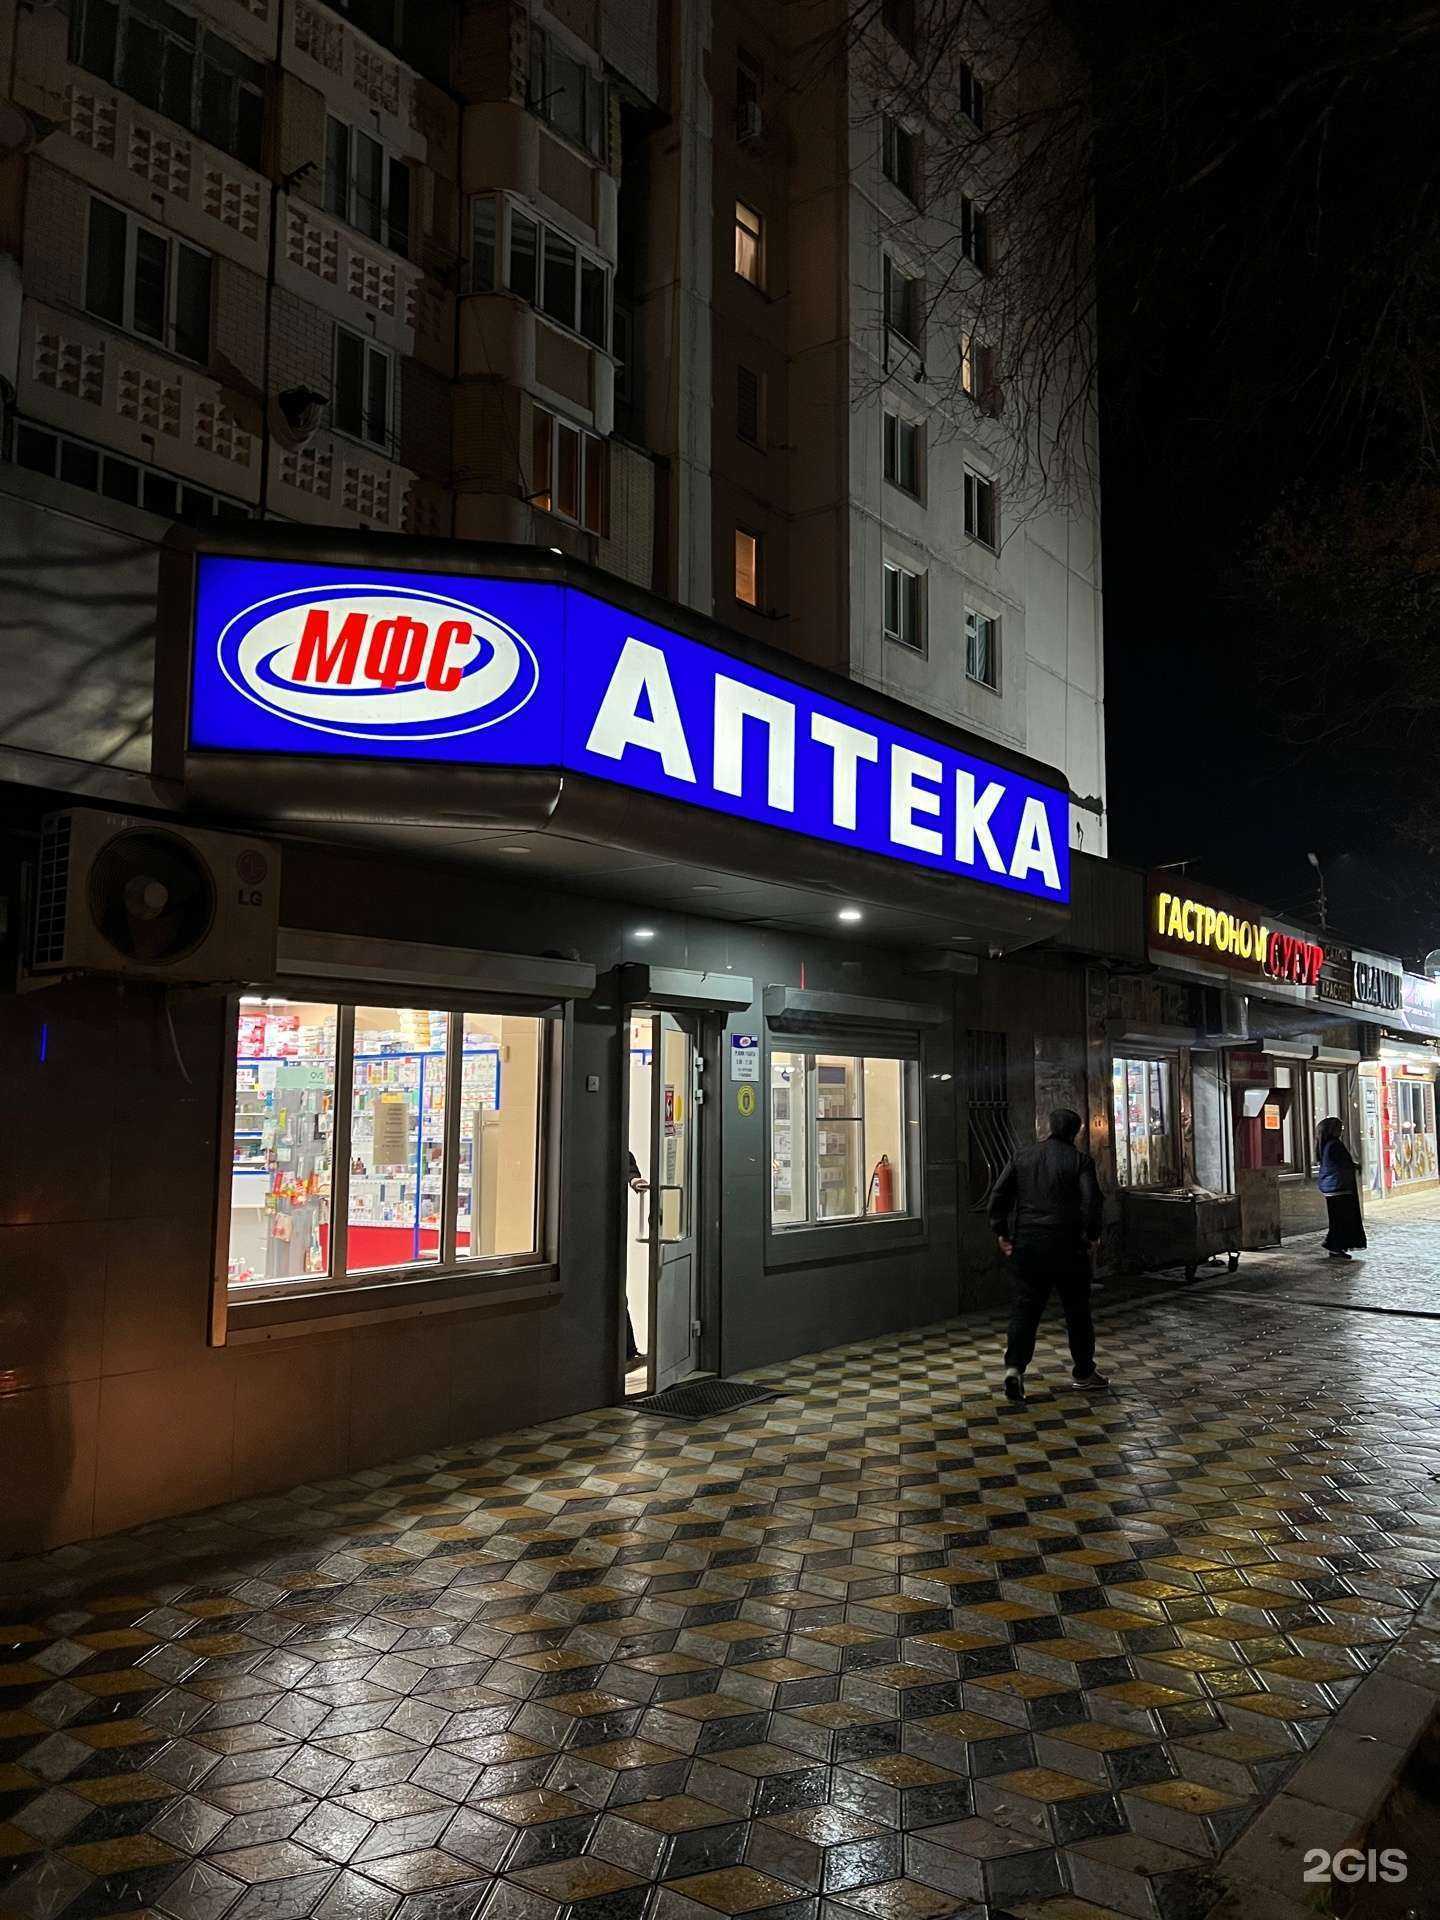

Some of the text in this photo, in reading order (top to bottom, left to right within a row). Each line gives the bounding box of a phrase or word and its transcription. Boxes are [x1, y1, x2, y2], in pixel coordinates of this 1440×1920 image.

[291, 609, 473, 692] МФС
[586, 636, 1062, 890] АПТЕКА
[238, 890, 263, 906] LG
